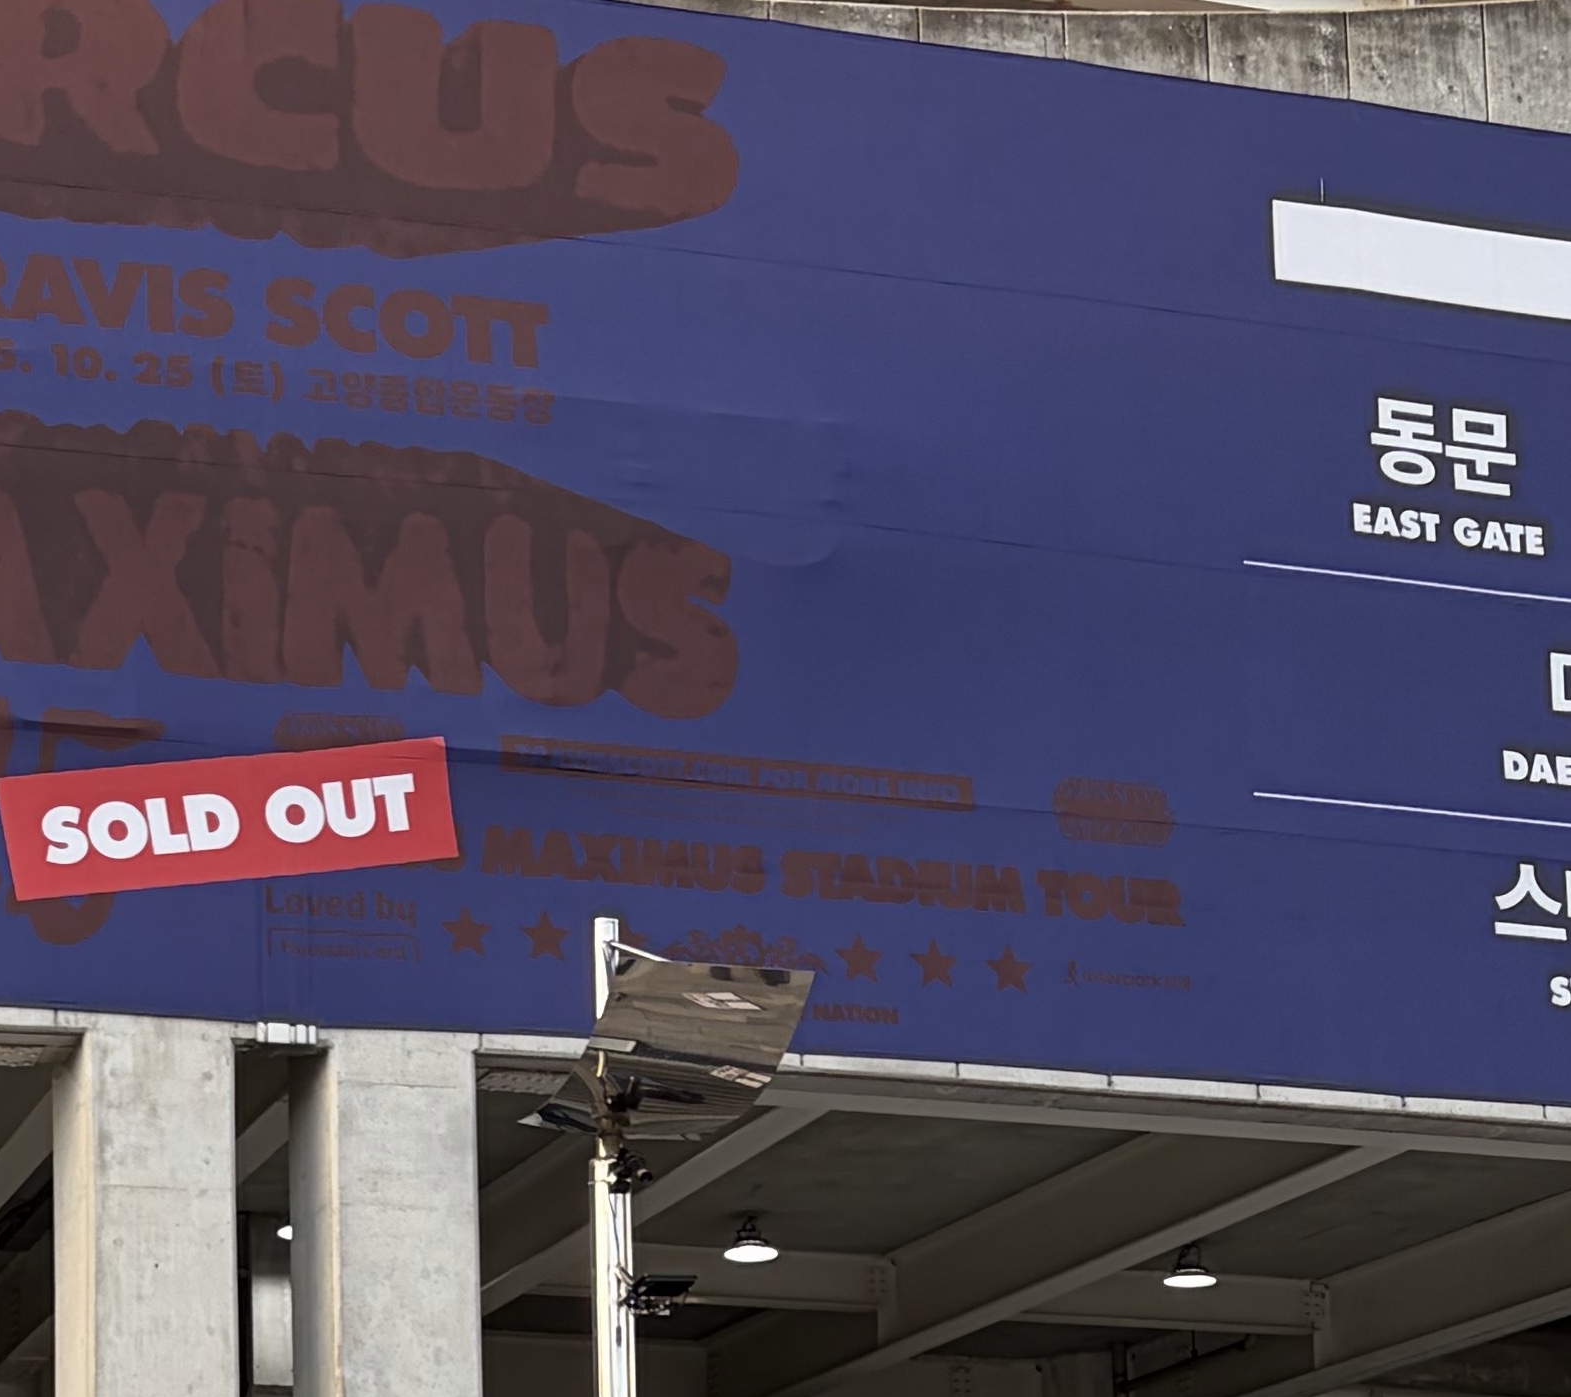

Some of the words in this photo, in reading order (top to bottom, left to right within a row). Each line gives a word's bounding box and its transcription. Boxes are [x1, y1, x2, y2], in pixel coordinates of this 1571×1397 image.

[48, 342, 118, 383] 10.
[131, 352, 194, 390] 25
[264, 275, 550, 370] SCOTT
[1370, 397, 1517, 497] 동문
[1352, 502, 1440, 542] EAST
[1453, 517, 1546, 556] GATE
[41, 792, 240, 866] SOLD
[264, 772, 415, 844] OUT
[262, 883, 366, 922] Loved
[373, 889, 419, 930] by
[480, 824, 766, 895] MAXIMUS
[779, 847, 1027, 916] STADIUM
[1035, 866, 1186, 928] TOUR
